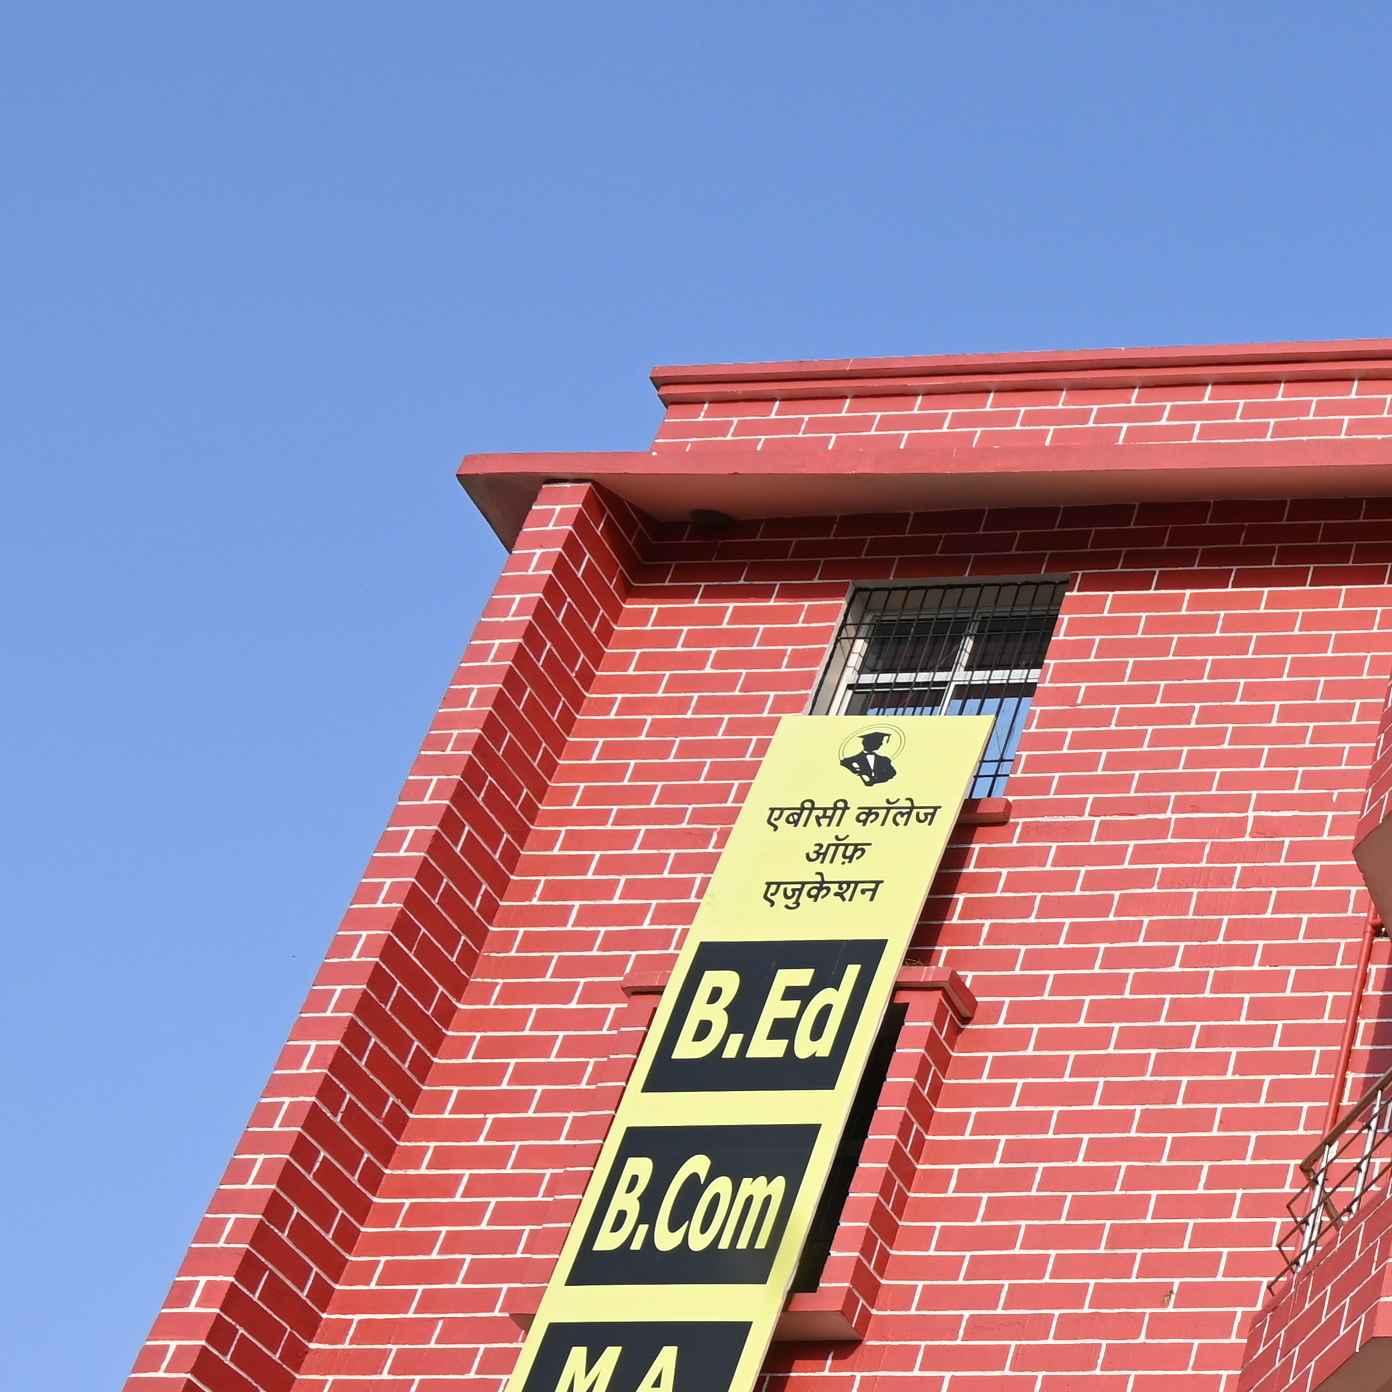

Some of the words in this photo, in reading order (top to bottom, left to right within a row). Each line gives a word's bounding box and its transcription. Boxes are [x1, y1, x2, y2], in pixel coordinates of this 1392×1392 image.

[766, 798, 851, 832] एबीसी
[855, 797, 942, 827] कॉलेज
[762, 871, 885, 910] एजुकेशन
[671, 964, 863, 1060] B.Ed
[592, 1153, 788, 1252] B.Com
